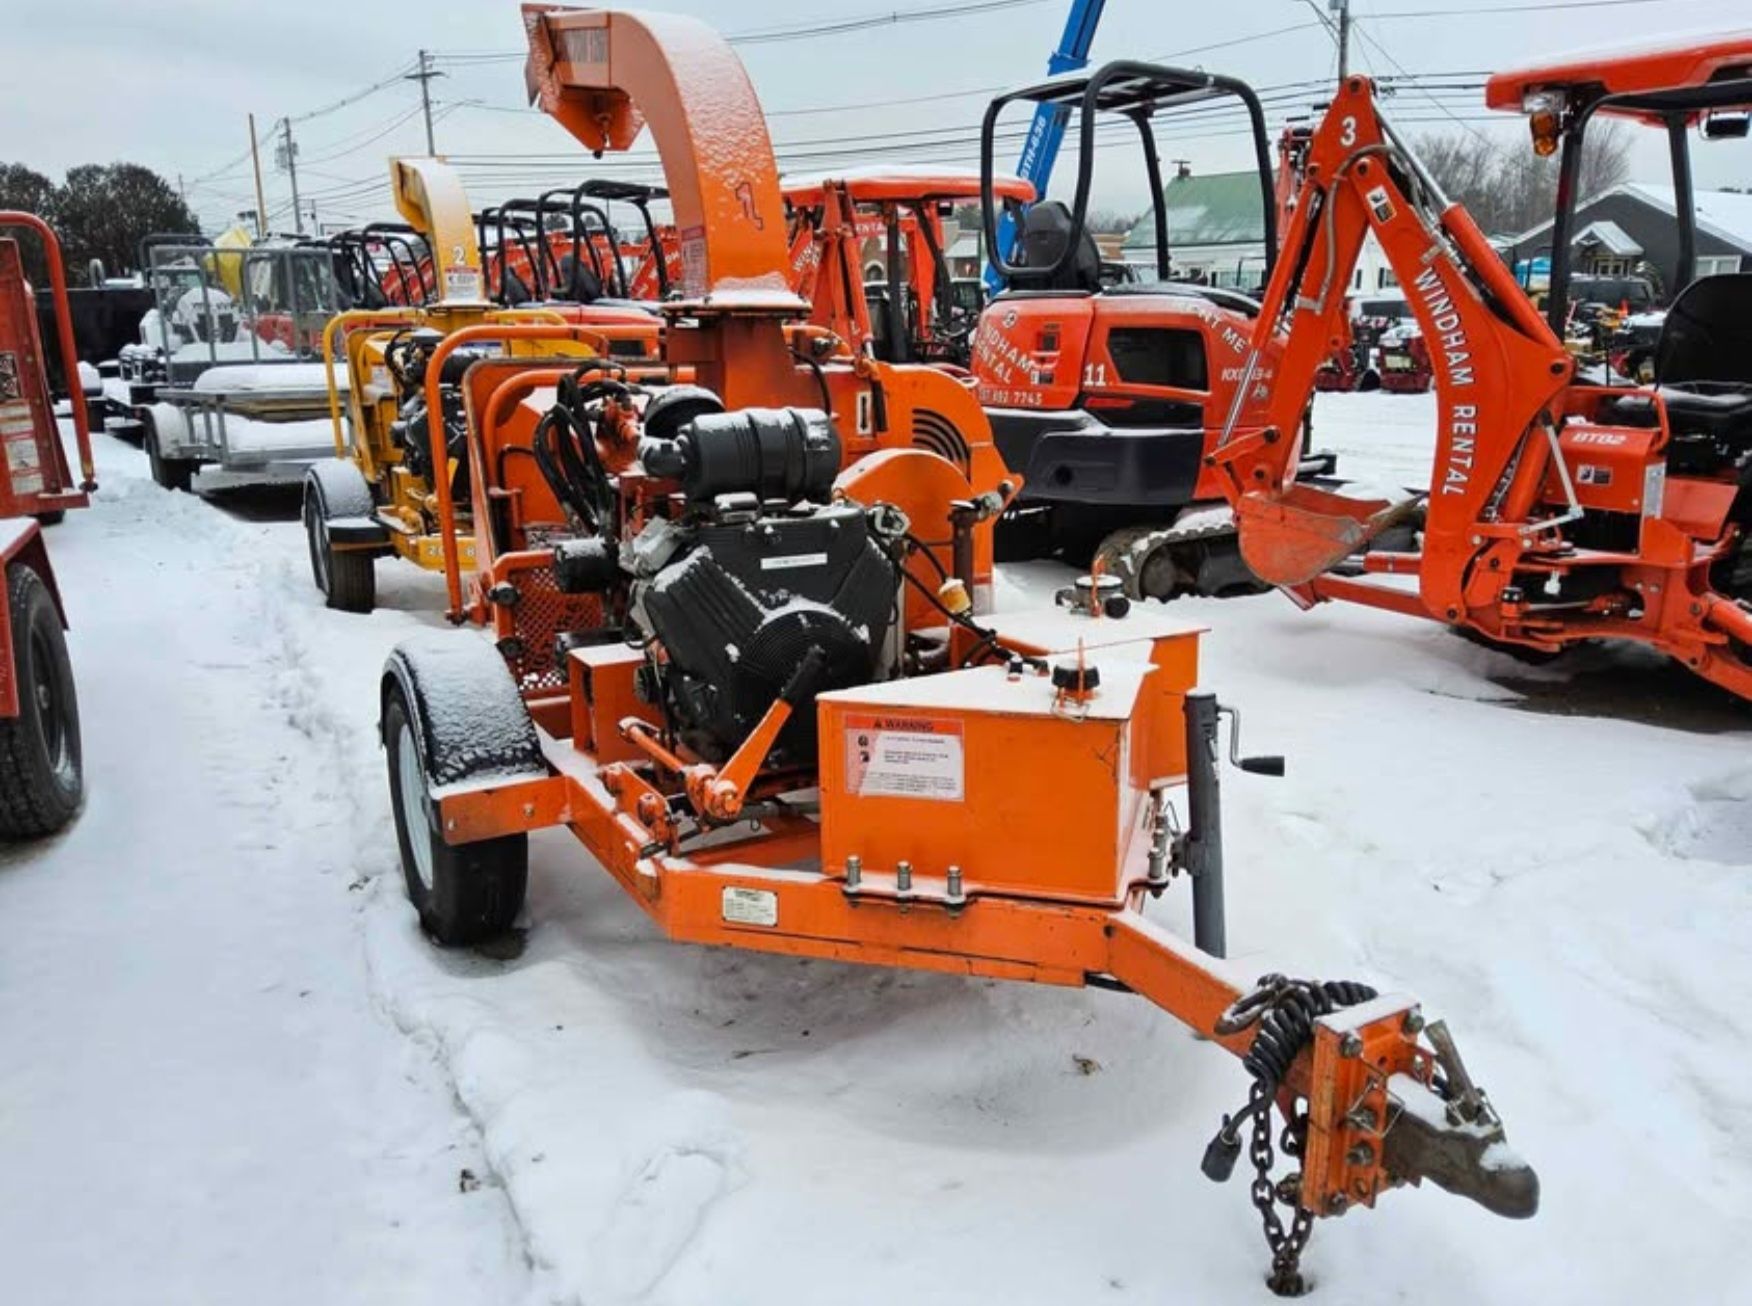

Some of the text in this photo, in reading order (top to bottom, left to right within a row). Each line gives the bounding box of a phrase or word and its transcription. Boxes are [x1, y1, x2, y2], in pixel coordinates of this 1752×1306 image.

[1340, 115, 1357, 146] 3
[452, 245, 466, 265] 2
[1221, 326, 1247, 354] ME
[1083, 363, 1107, 387] 11
[1413, 265, 1478, 496] WINDHAM RENTAL
